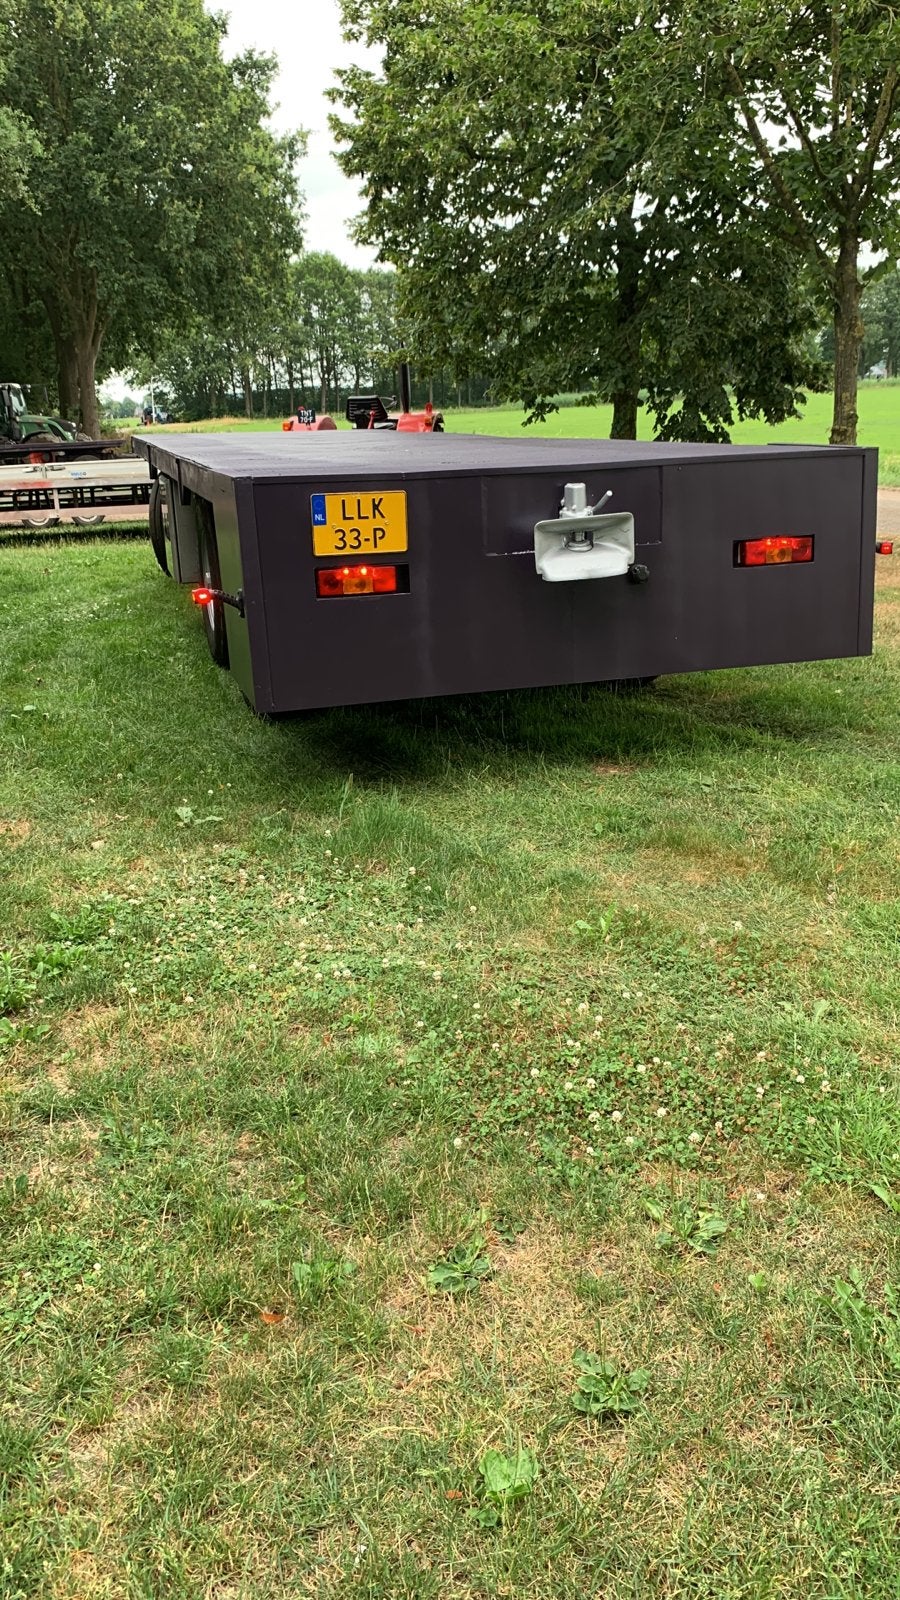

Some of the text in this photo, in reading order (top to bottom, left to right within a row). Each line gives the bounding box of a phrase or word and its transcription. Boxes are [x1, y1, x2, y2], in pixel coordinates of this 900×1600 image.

[314, 513, 325, 521] NL
[341, 497, 386, 521] LLK
[334, 527, 386, 550] 33-P
